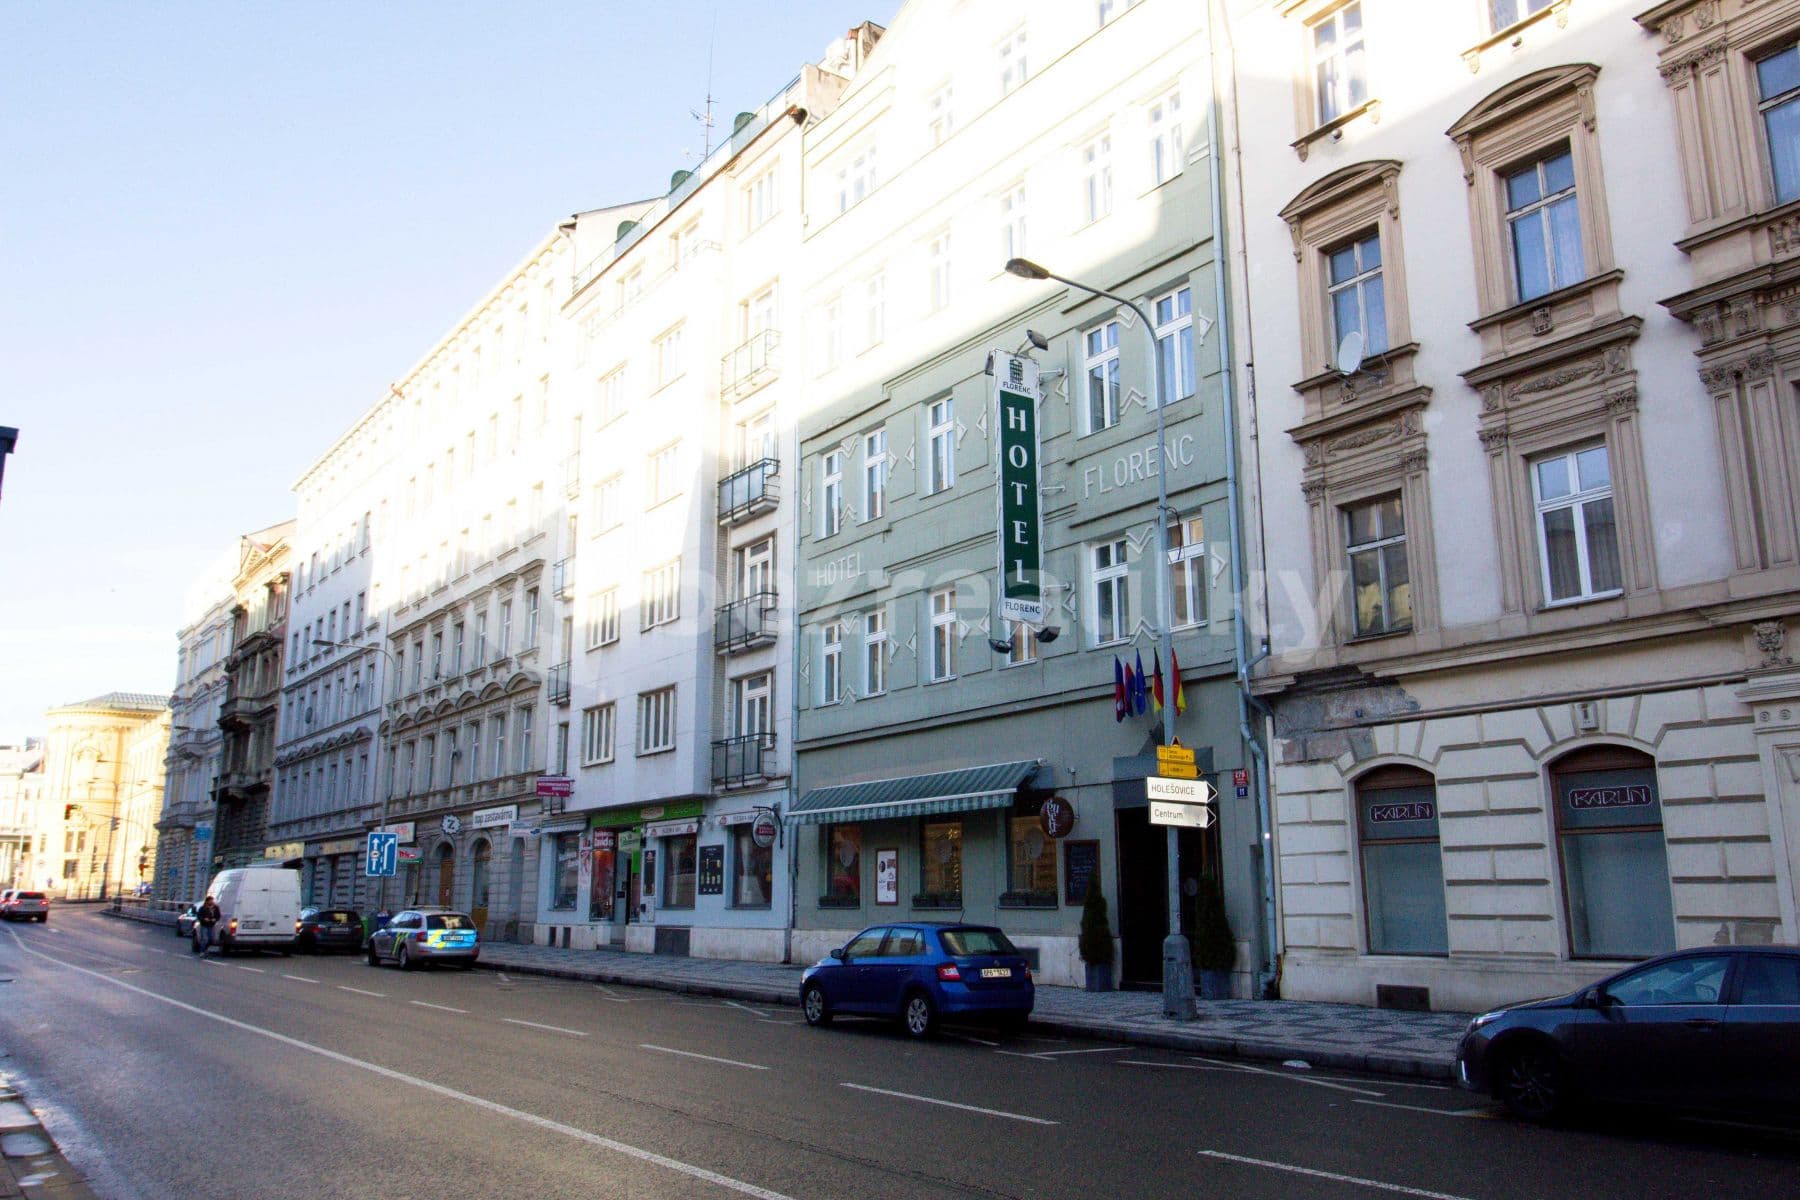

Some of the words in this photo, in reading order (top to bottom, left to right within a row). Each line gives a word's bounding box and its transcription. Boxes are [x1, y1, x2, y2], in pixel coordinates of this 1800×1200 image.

[1002, 381, 1031, 394] FLORENC
[1083, 434, 1194, 499] FLORENC
[1007, 406, 1030, 584] HOTEL
[816, 552, 867, 588] HOTEL
[1005, 601, 1041, 614] FLORENC
[1151, 782, 1196, 796] HOLEŠOVICE
[1154, 808, 1184, 820] Centrum
